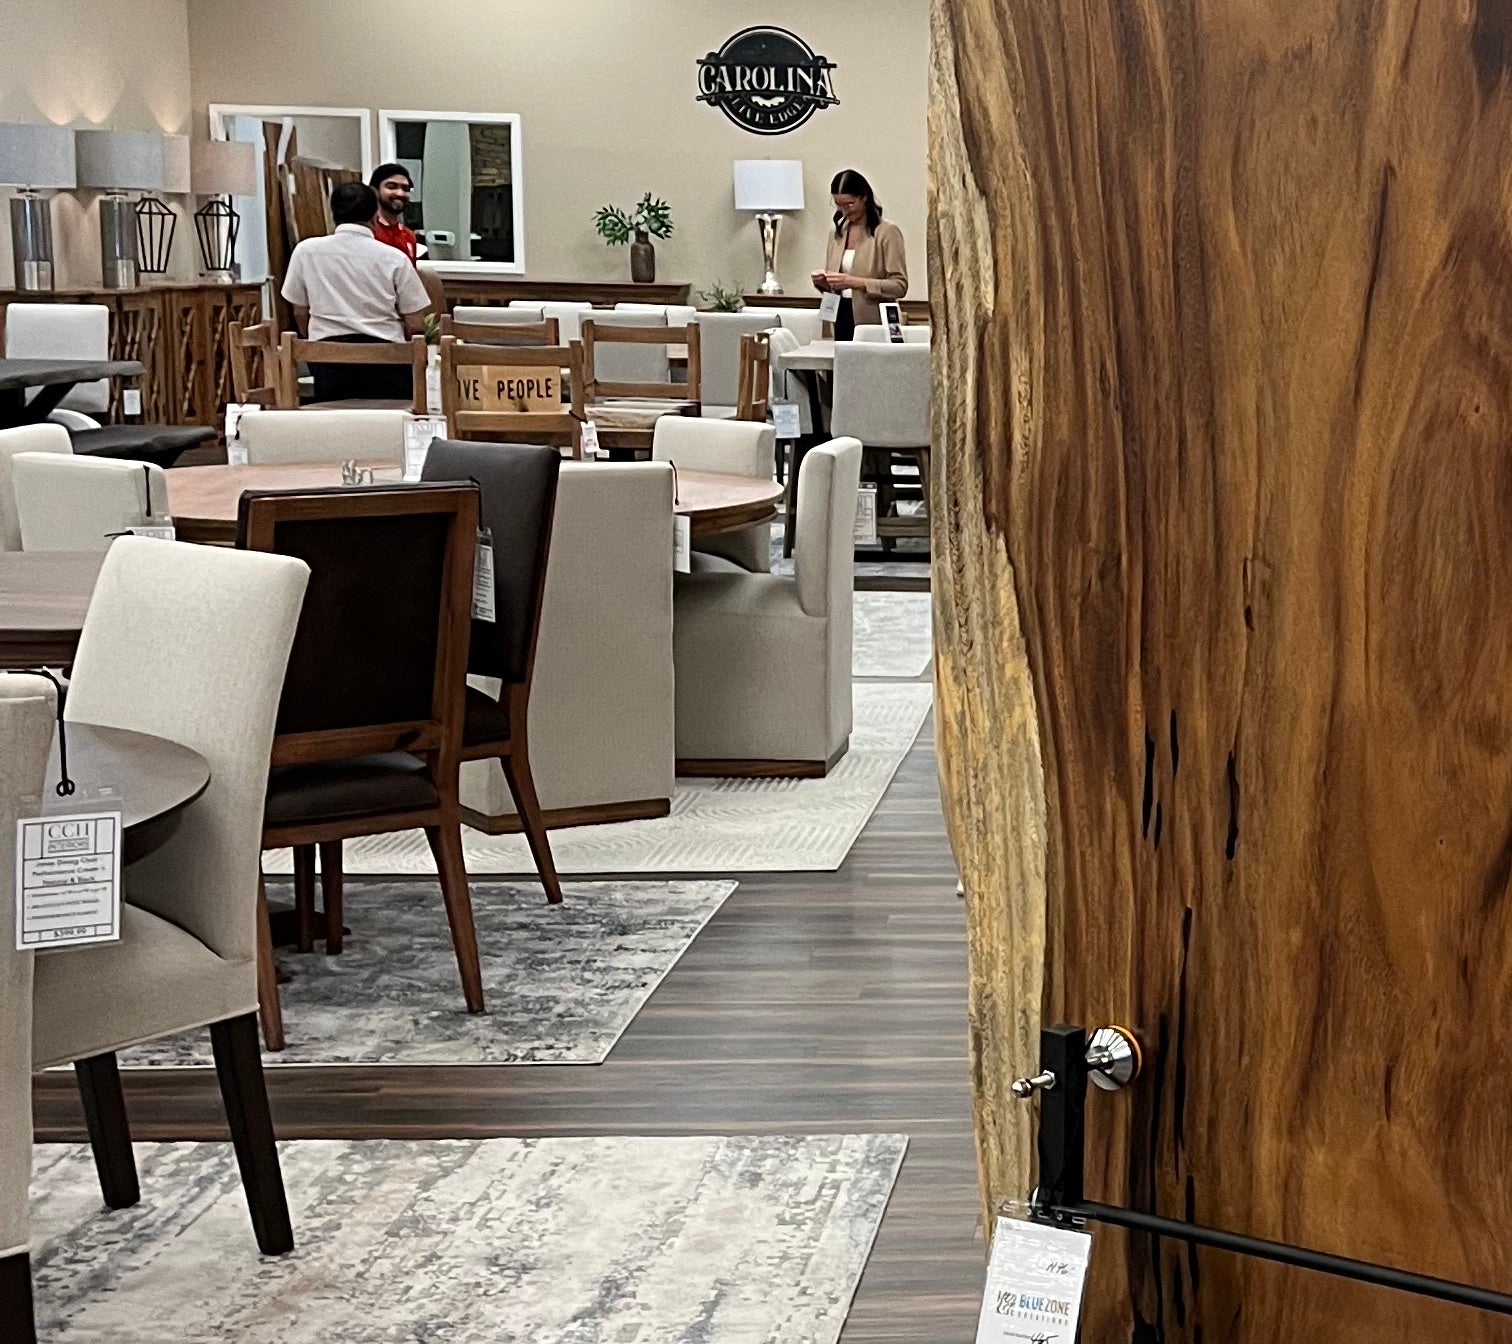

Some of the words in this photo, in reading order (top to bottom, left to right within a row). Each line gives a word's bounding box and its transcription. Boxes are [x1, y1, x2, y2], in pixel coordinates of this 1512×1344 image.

[700, 64, 835, 99] CAROLINA
[731, 97, 763, 124] LIVE
[769, 102, 803, 124] EDGE
[497, 377, 553, 401] PEOPLE
